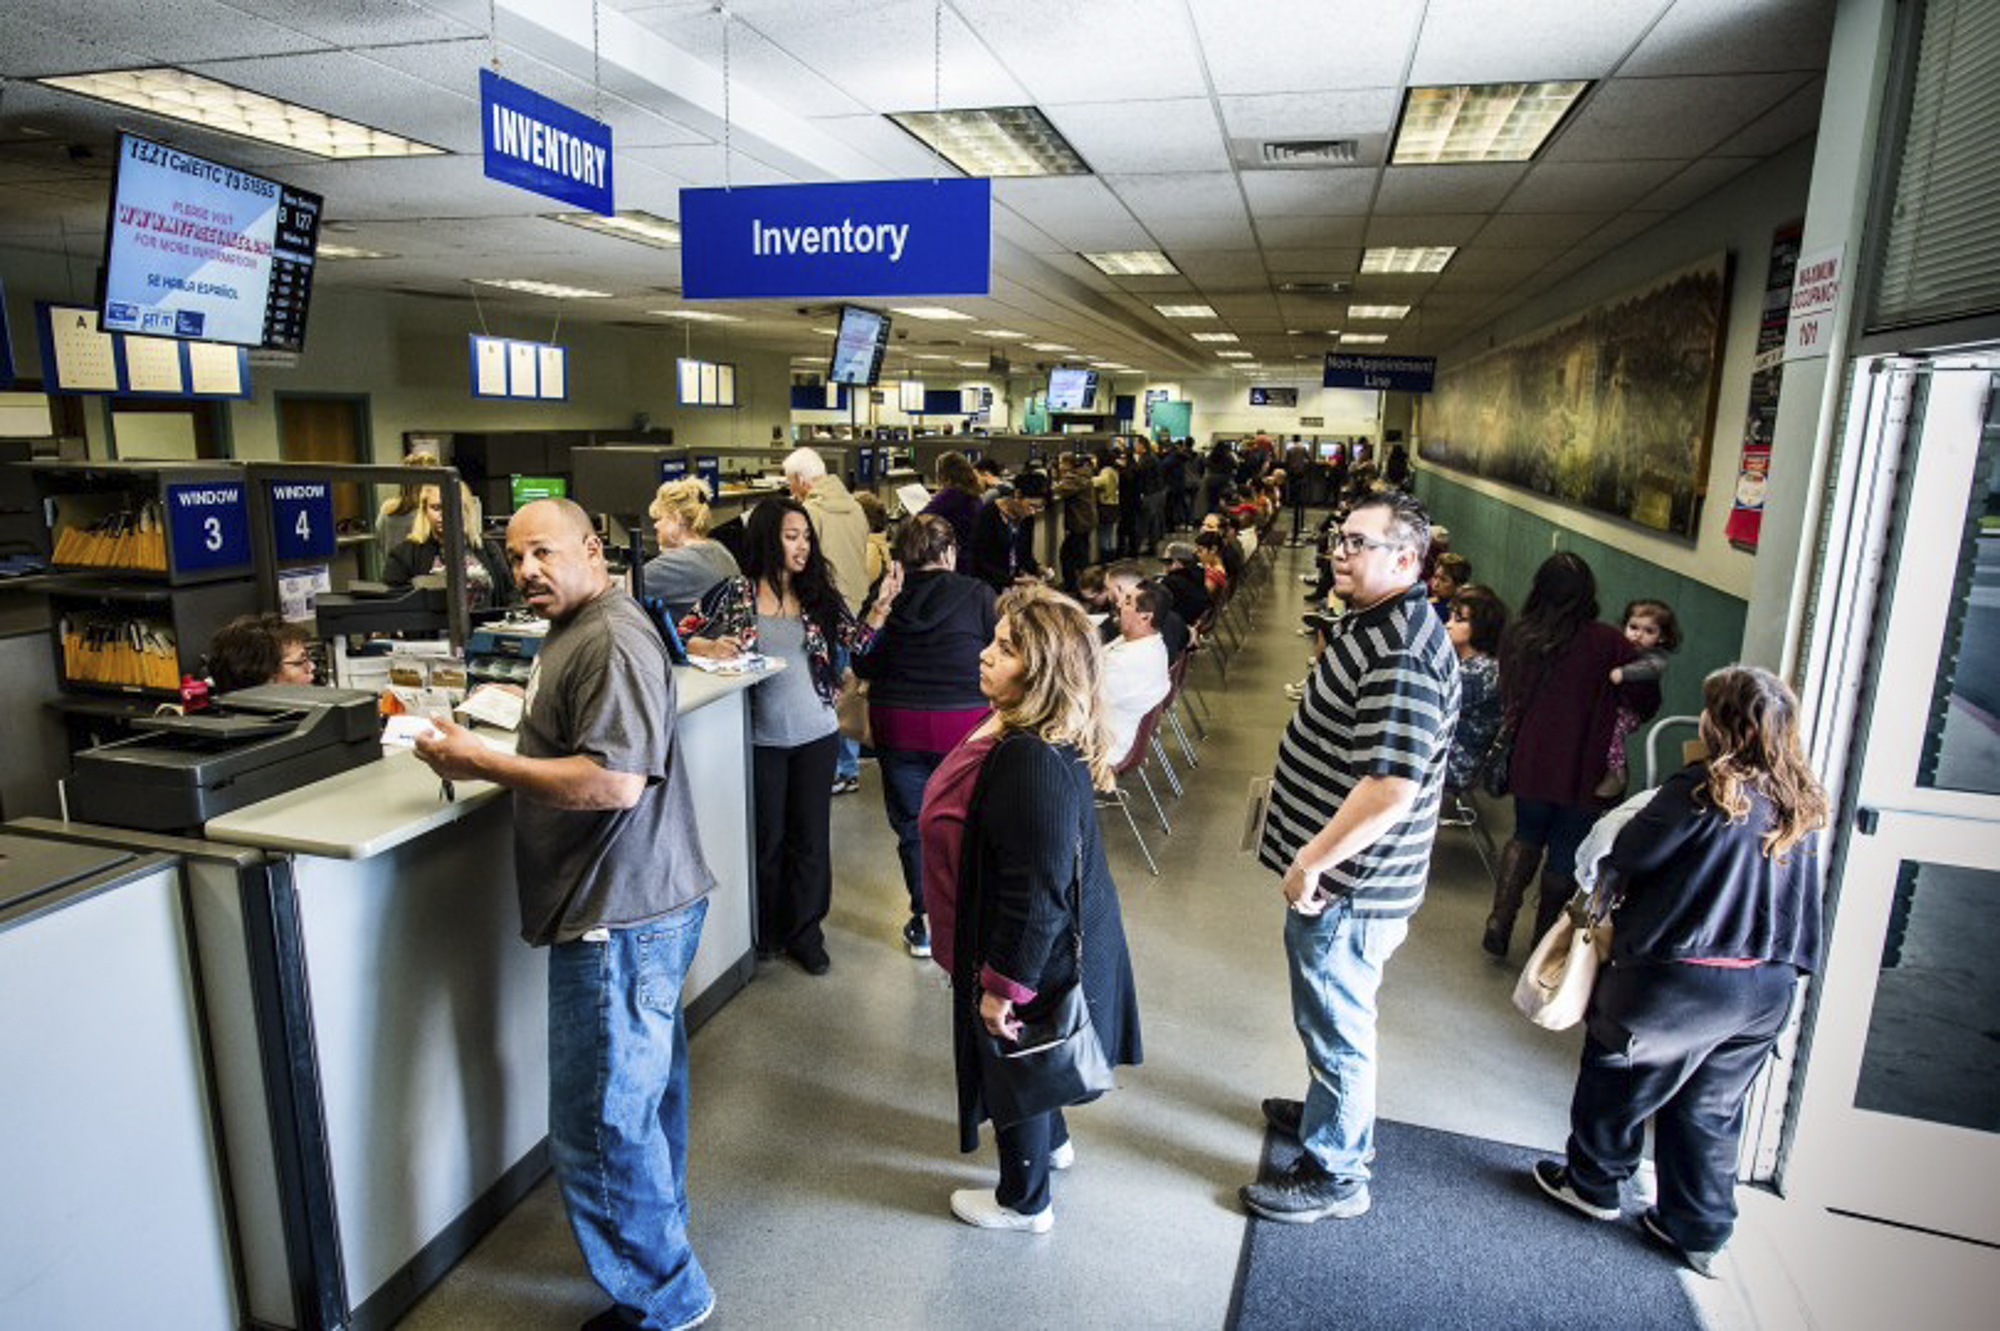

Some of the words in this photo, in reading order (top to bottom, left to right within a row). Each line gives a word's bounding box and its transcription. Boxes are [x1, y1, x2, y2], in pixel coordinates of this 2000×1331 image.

[493, 103, 606, 189] INVENTORY
[753, 217, 910, 263] Inventory
[1328, 355, 1434, 374] Non-Appointment
[178, 488, 239, 507] WINDOW
[273, 484, 325, 500] WINDOW
[204, 516, 223, 552] 3
[295, 510, 311, 542] 4
